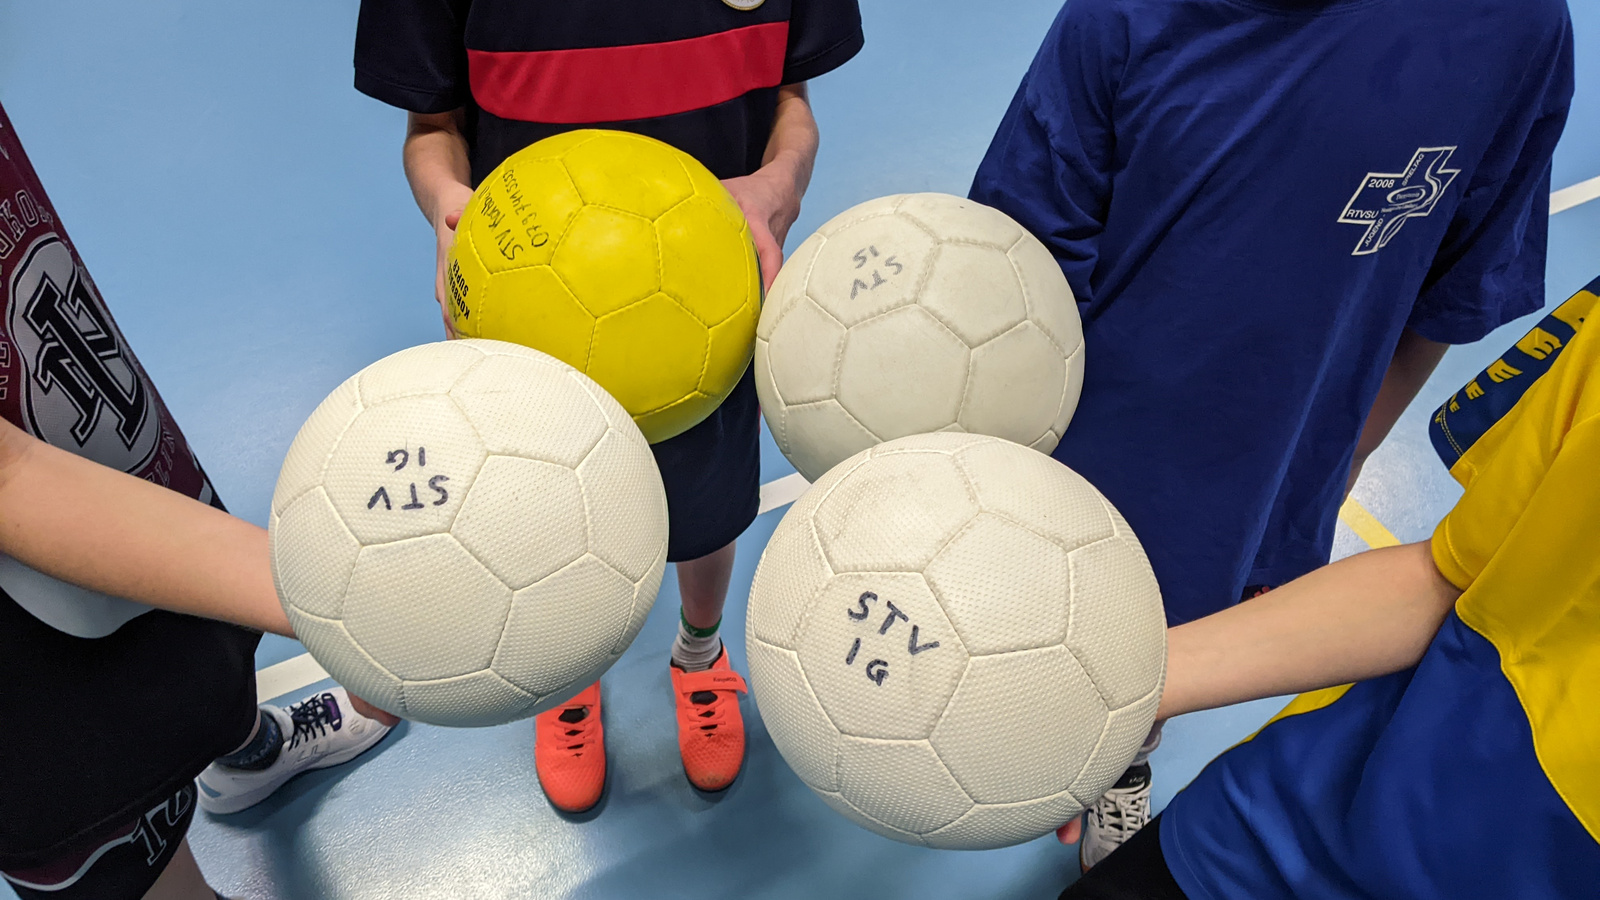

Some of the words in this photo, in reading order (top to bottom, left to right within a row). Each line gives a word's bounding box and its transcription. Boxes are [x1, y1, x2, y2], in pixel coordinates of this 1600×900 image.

[1364, 217, 1384, 247] JUGEND
[1401, 153, 1425, 186] SPIELTAG
[1368, 178, 1395, 189] 2008
[1345, 208, 1379, 219] RTVSU
[494, 229, 524, 261] STV
[453, 258, 469, 297] SUPER
[849, 255, 903, 301] STV
[385, 446, 426, 472] IG
[367, 474, 450, 511] STV
[847, 591, 940, 655] STV
[845, 637, 889, 686] IG
